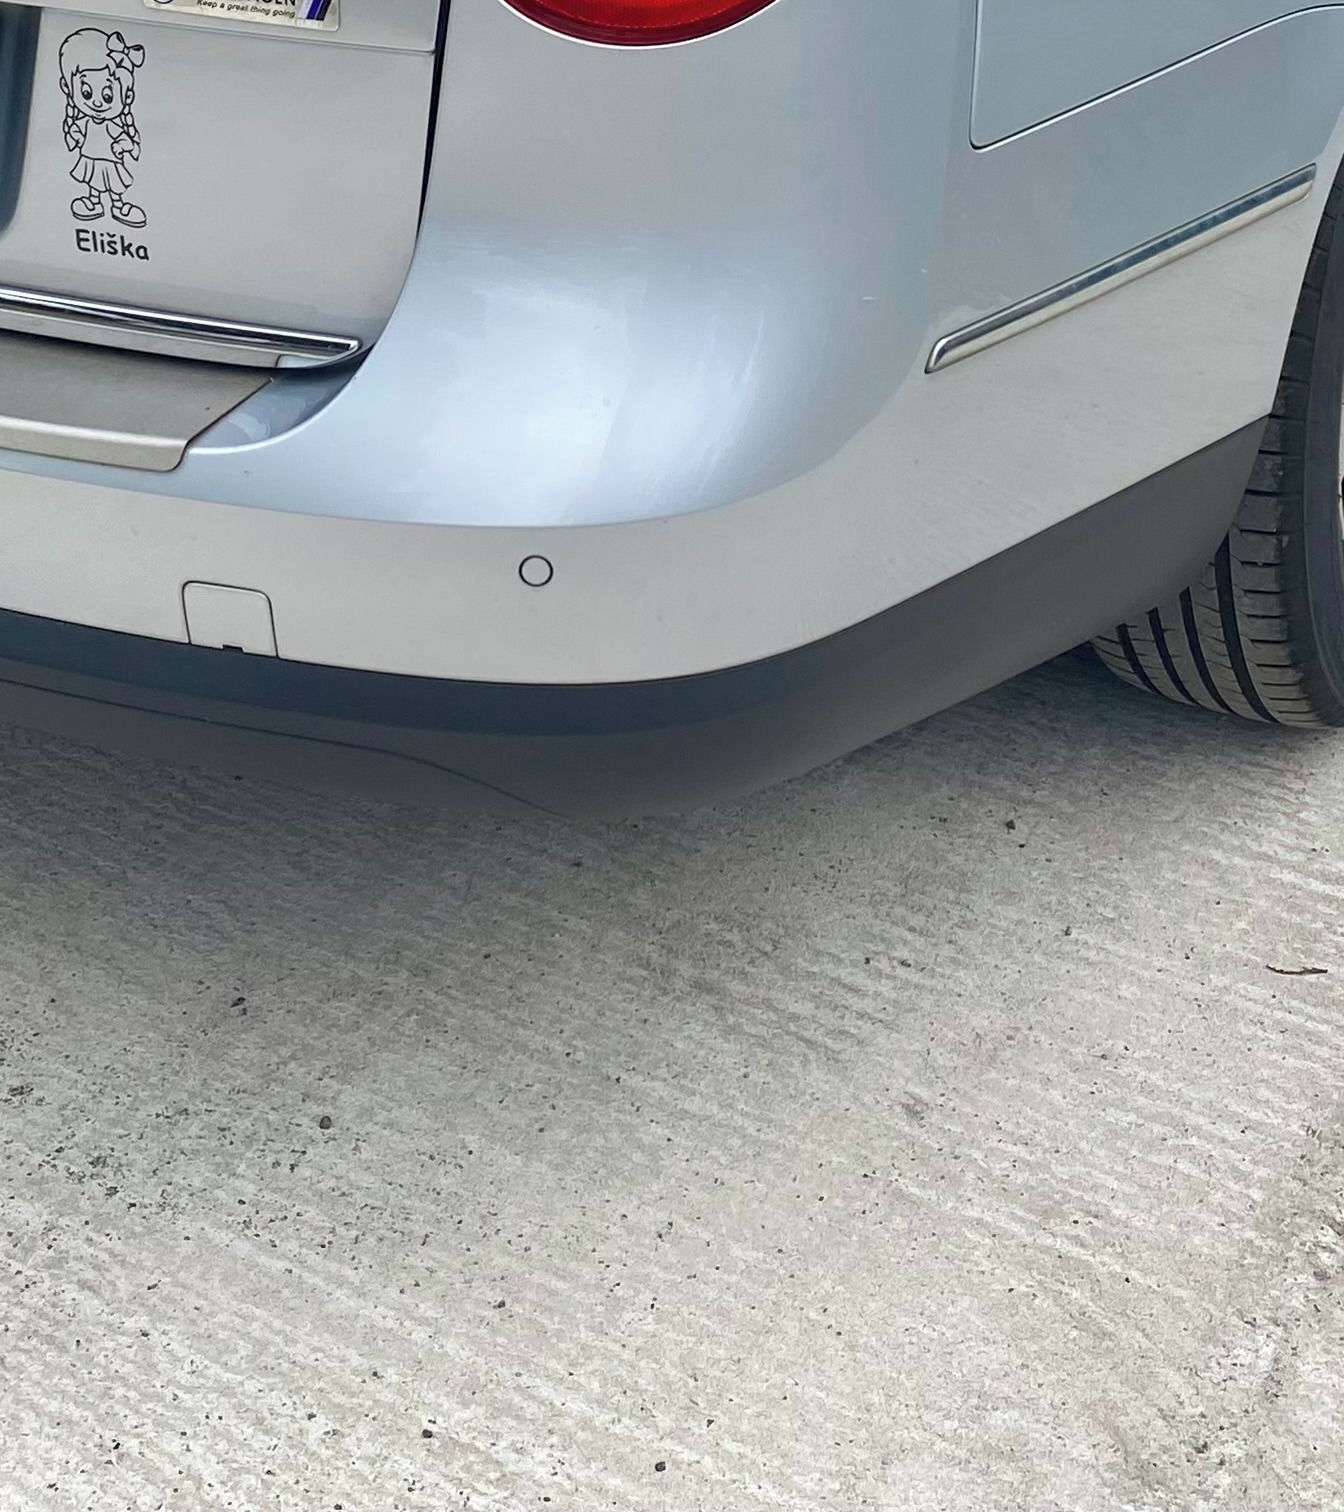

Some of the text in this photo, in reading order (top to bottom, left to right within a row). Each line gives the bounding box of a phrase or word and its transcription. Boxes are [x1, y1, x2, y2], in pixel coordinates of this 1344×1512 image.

[197, 0, 217, 9] Keep
[272, 9, 296, 19] going
[75, 228, 150, 261] Eliška
